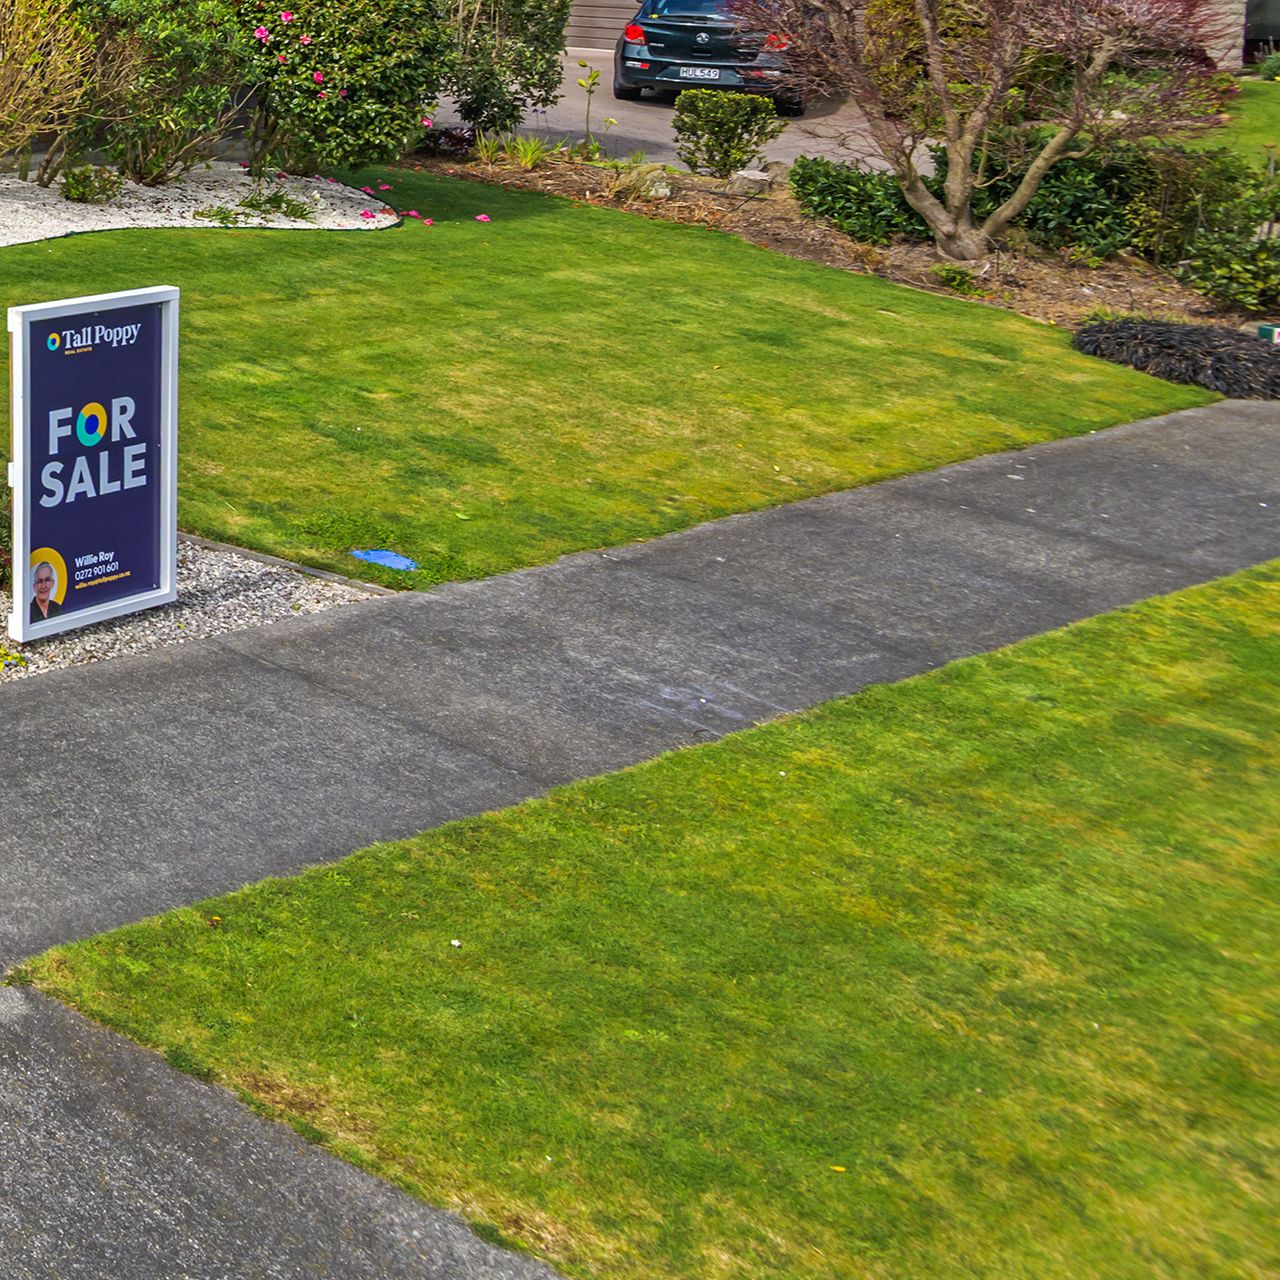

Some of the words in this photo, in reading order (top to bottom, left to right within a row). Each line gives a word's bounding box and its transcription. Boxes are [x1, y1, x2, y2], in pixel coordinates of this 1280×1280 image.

[682, 68, 718, 78] HUL549
[62, 326, 92, 349] Tall
[94, 323, 142, 347] Poppy
[48, 396, 137, 455] FOR
[39, 442, 147, 508] SALE
[75, 554, 98, 568] Willie
[99, 552, 114, 561] Roy
[75, 568, 92, 580] 0272
[93, 564, 105, 576] 901
[106, 561, 119, 572] 601
